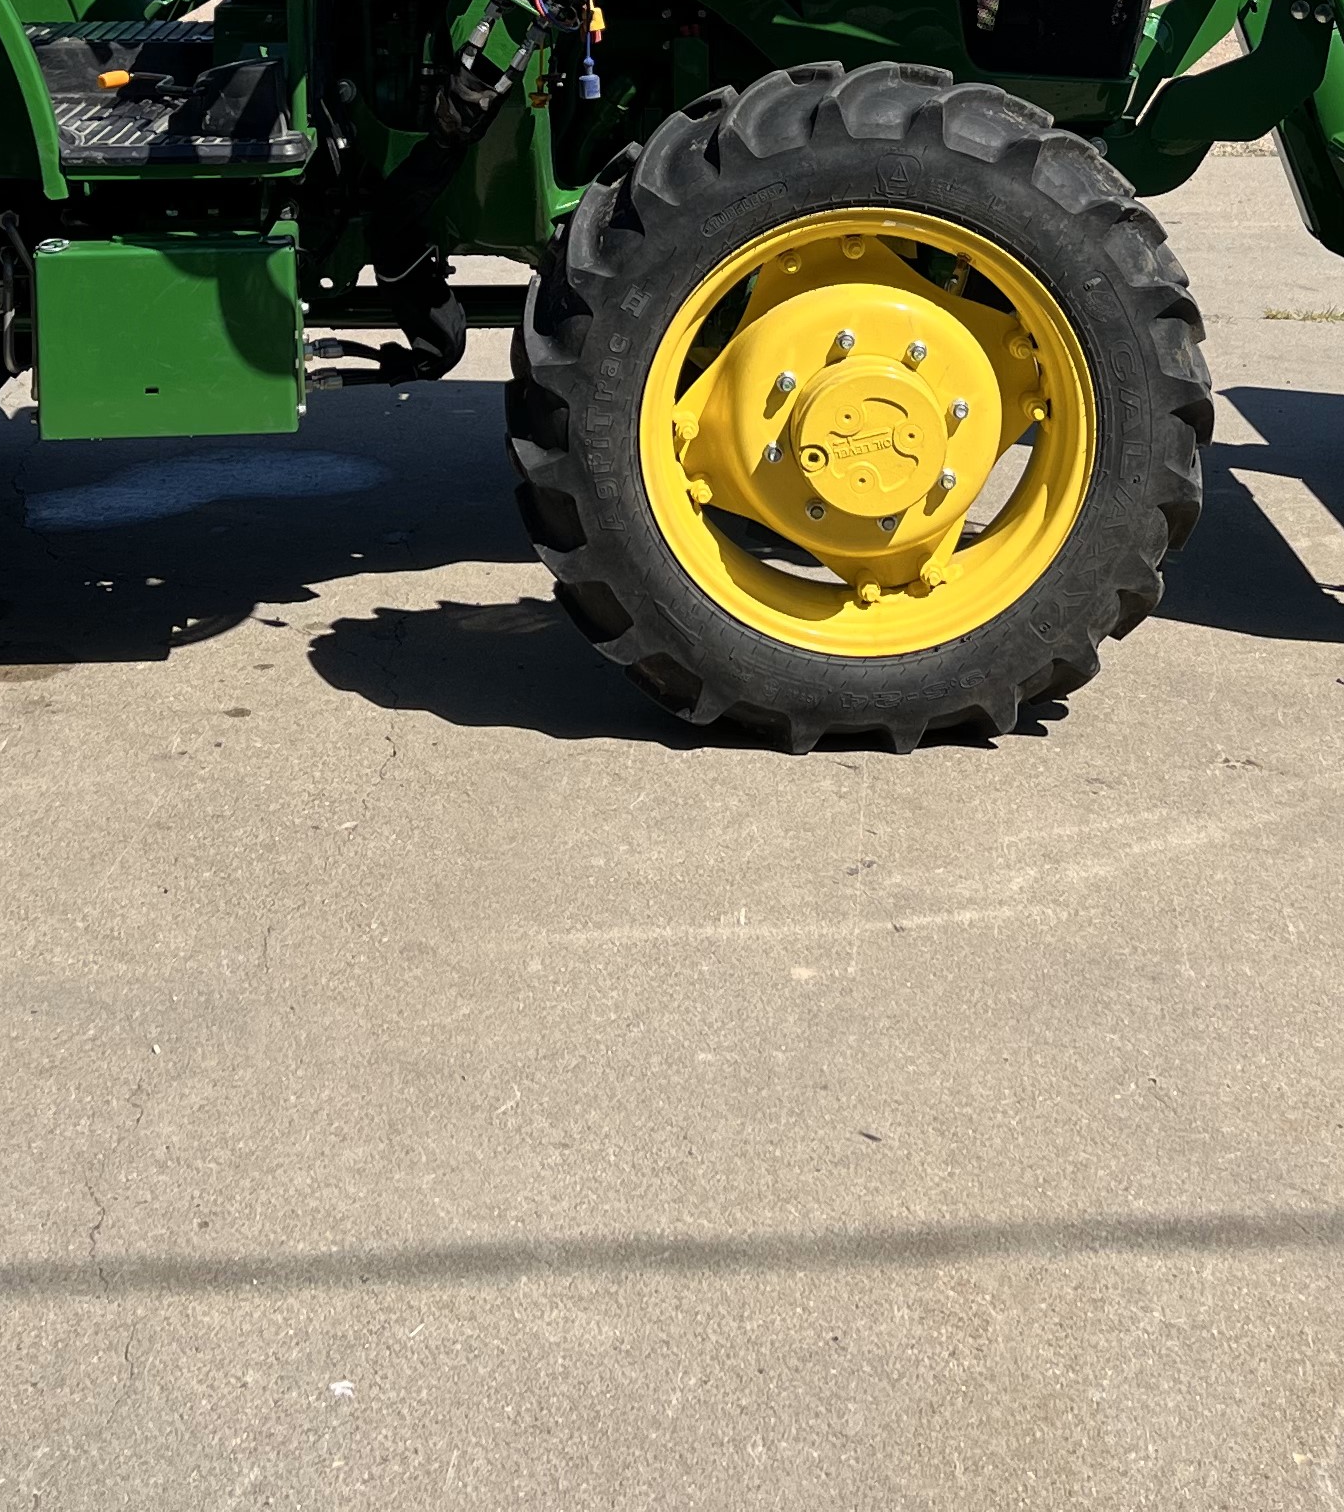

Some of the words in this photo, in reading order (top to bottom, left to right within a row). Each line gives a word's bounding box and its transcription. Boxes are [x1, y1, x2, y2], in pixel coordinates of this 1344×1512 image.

[582, 327, 631, 539] AgriTrac
[832, 444, 870, 459] LEVEL
[873, 439, 892, 450] OIL
[1048, 337, 1147, 629] GALAXY
